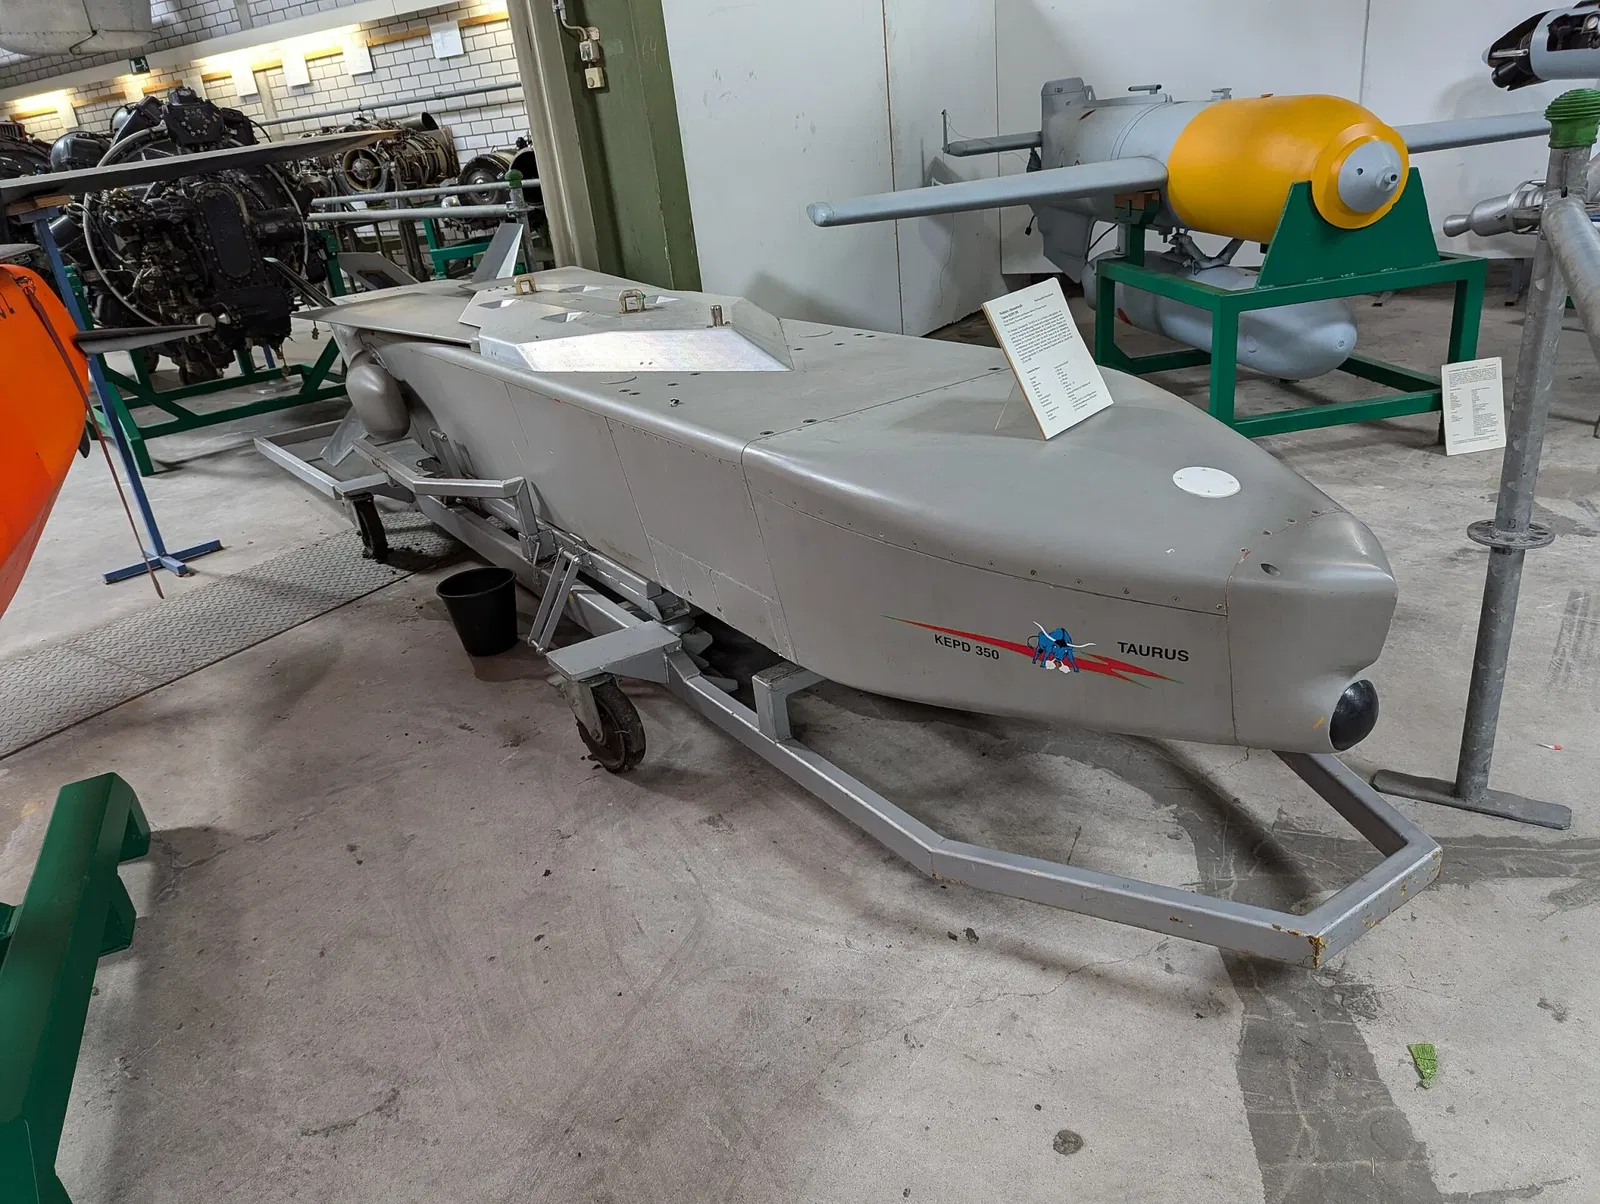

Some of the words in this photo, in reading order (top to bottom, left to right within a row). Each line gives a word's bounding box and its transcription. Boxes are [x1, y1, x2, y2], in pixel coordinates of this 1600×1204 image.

[934, 634, 971, 653] KEPD
[975, 645, 1000, 660] 350
[1117, 641, 1189, 662] TAURUS
